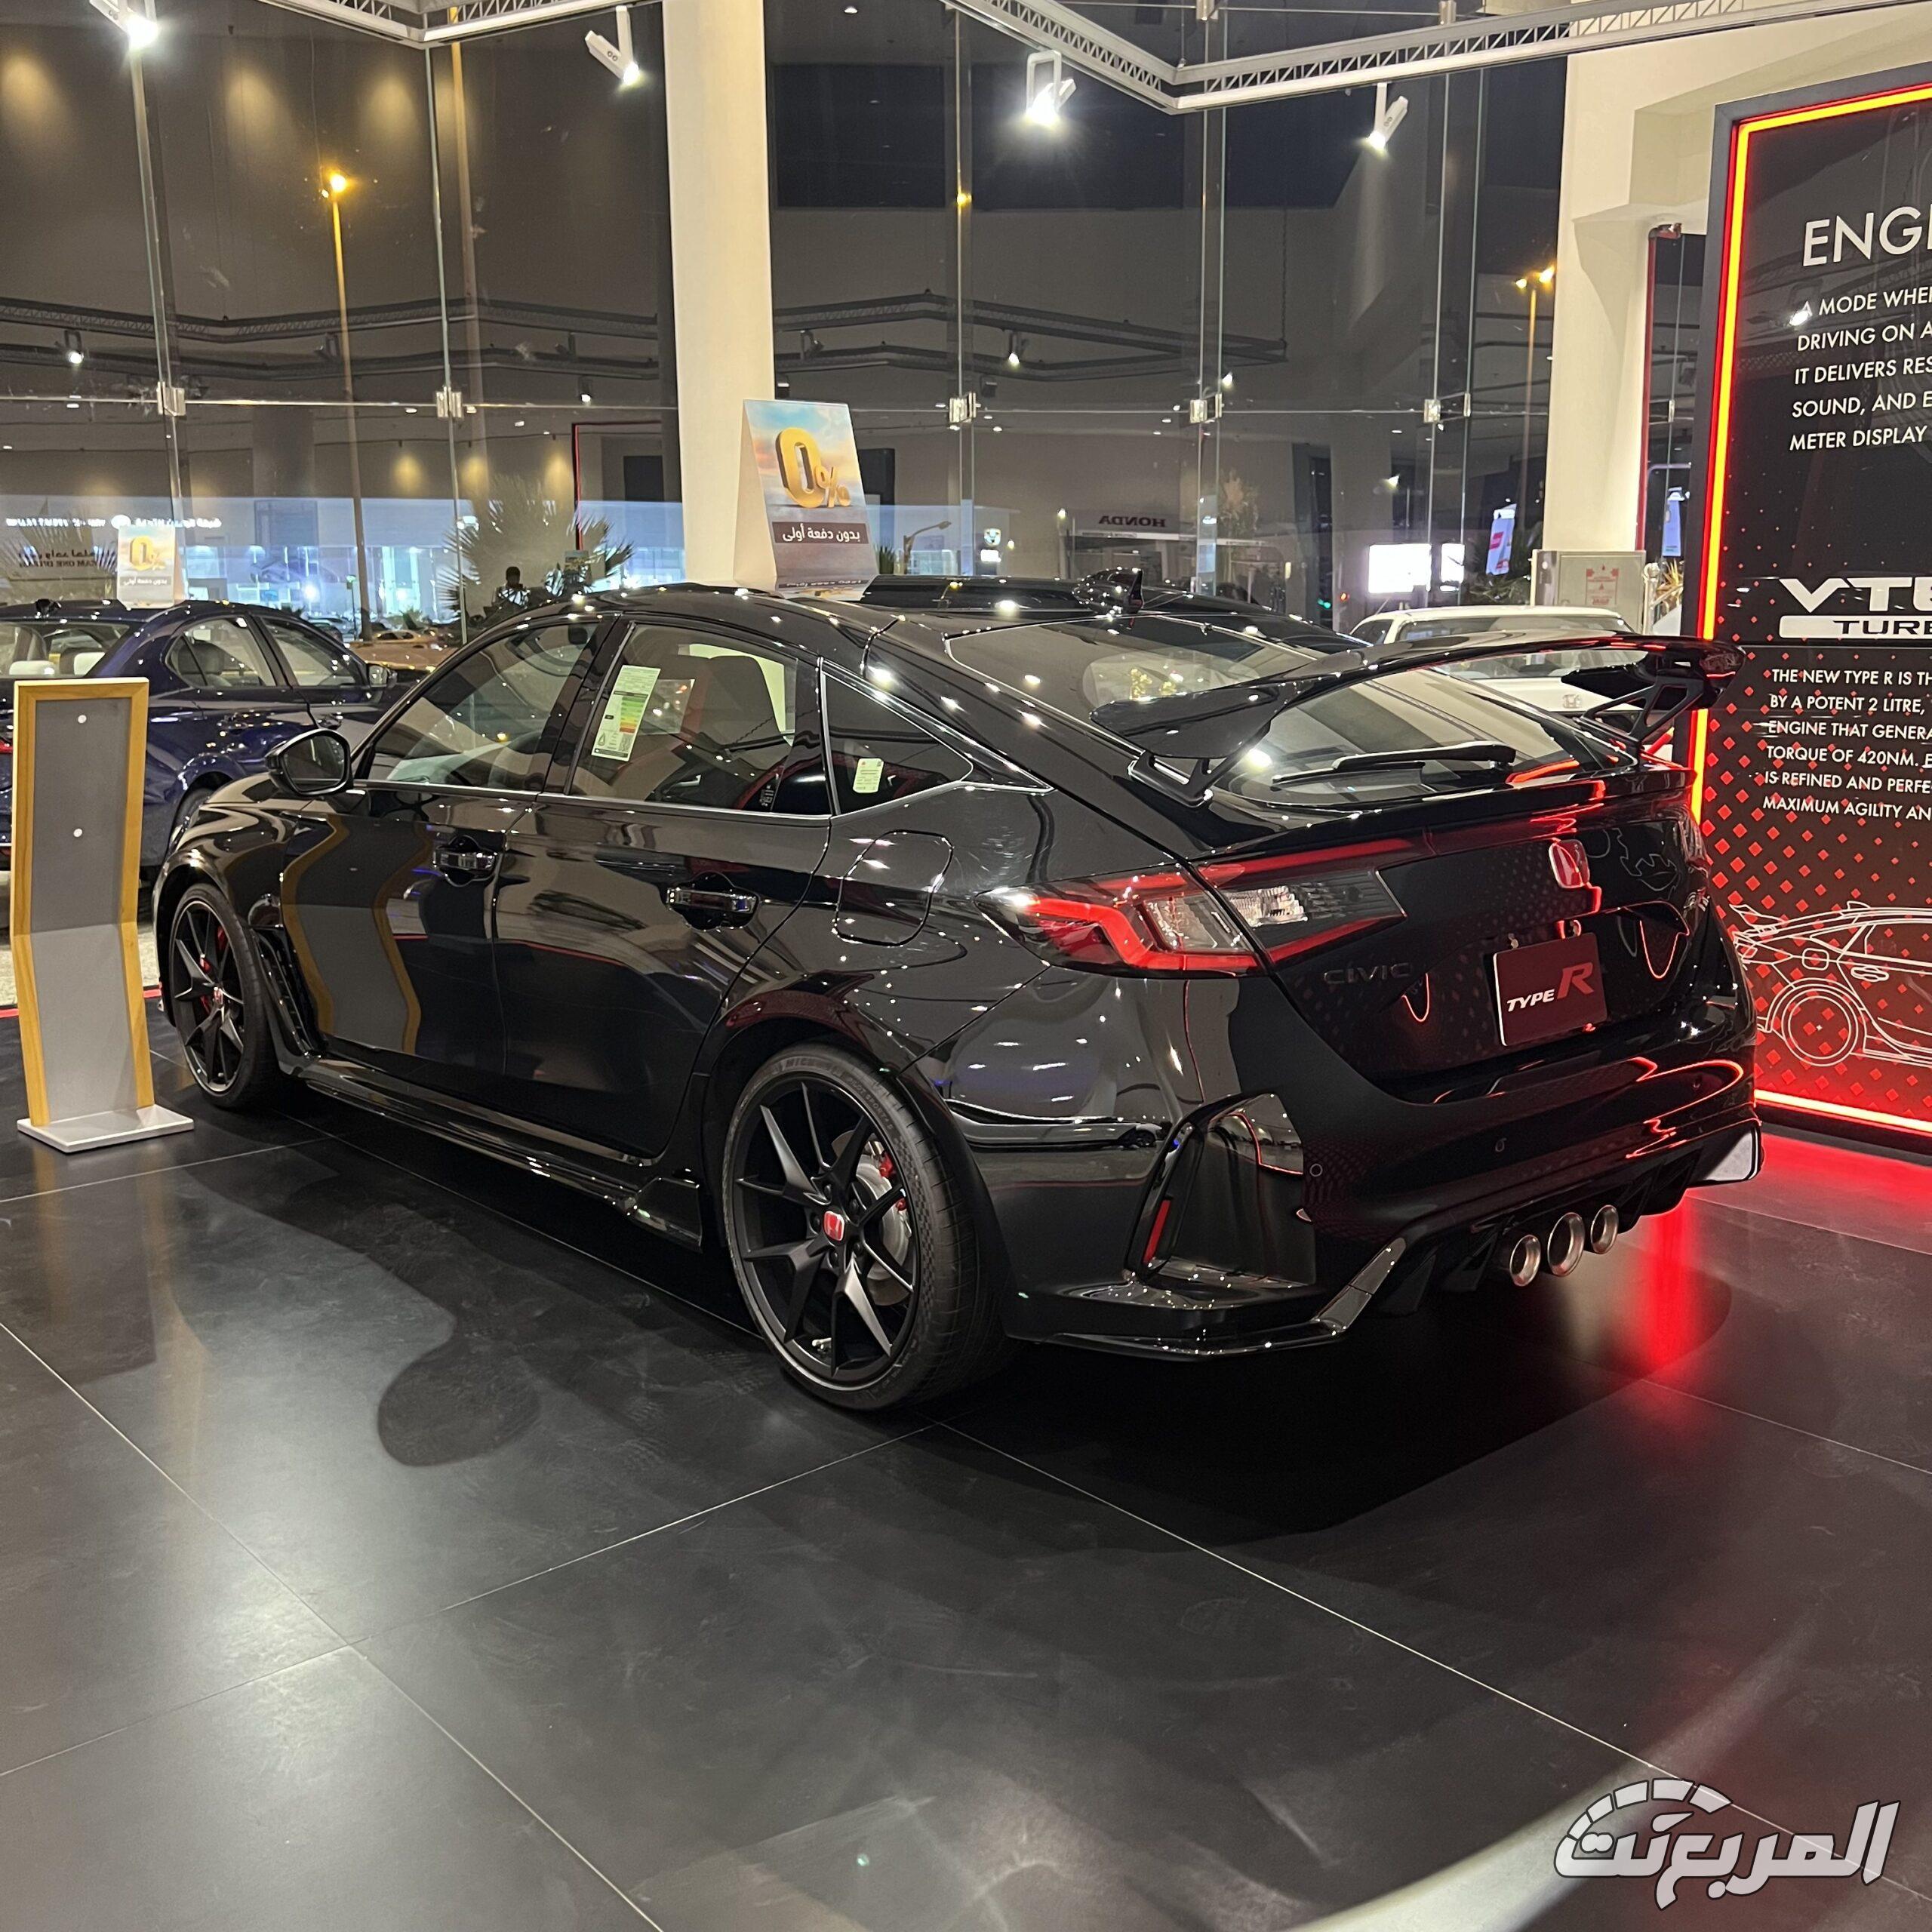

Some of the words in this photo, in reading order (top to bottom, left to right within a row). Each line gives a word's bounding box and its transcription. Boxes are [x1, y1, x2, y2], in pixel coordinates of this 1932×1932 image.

[1819, 293, 1877, 315] MODE
[1883, 286, 1932, 309] WHE
[1797, 328, 1876, 352] DRIVING
[1881, 323, 1915, 342] ON
[1795, 368, 1810, 385] IT
[1814, 359, 1897, 383] DELIVERS
[1792, 397, 1866, 418] SOUND,
[1872, 392, 1916, 412] AND
[1789, 432, 1846, 451] METER
[1852, 425, 1927, 448] DISPLAY
[775, 427, 851, 509] 0%
[782, 523, 805, 542] أولى
[808, 527, 833, 540] دفعة
[835, 529, 860, 542] بدون
[1772, 669, 1798, 683] THE
[1802, 669, 1841, 684] NEW
[1844, 669, 1879, 685] TYPE
[1884, 671, 1893, 685] R
[1898, 671, 1912, 685] IS
[1770, 694, 1787, 709] BY
[1791, 695, 1802, 709] A
[1807, 695, 1865, 712] POTENT
[1869, 697, 1878, 712] 2
[1883, 697, 1925, 715] LITRE,
[1768, 720, 1826, 736] ENGINE
[1831, 722, 1868, 737] THAT
[1767, 745, 1827, 762] TORQUE
[1832, 749, 1854, 763] OF
[1857, 750, 1918, 767] 420NM.
[1764, 771, 1777, 785] IS
[1782, 772, 1842, 788] REFINED
[1846, 775, 1882, 791] AND
[1763, 796, 1840, 814] MAXIMUM
[1844, 801, 1902, 818] AGILITY
[1324, 962, 1414, 984] CIVIC
[1506, 988, 1555, 1012] TYPE
[1556, 962, 1594, 999] R
